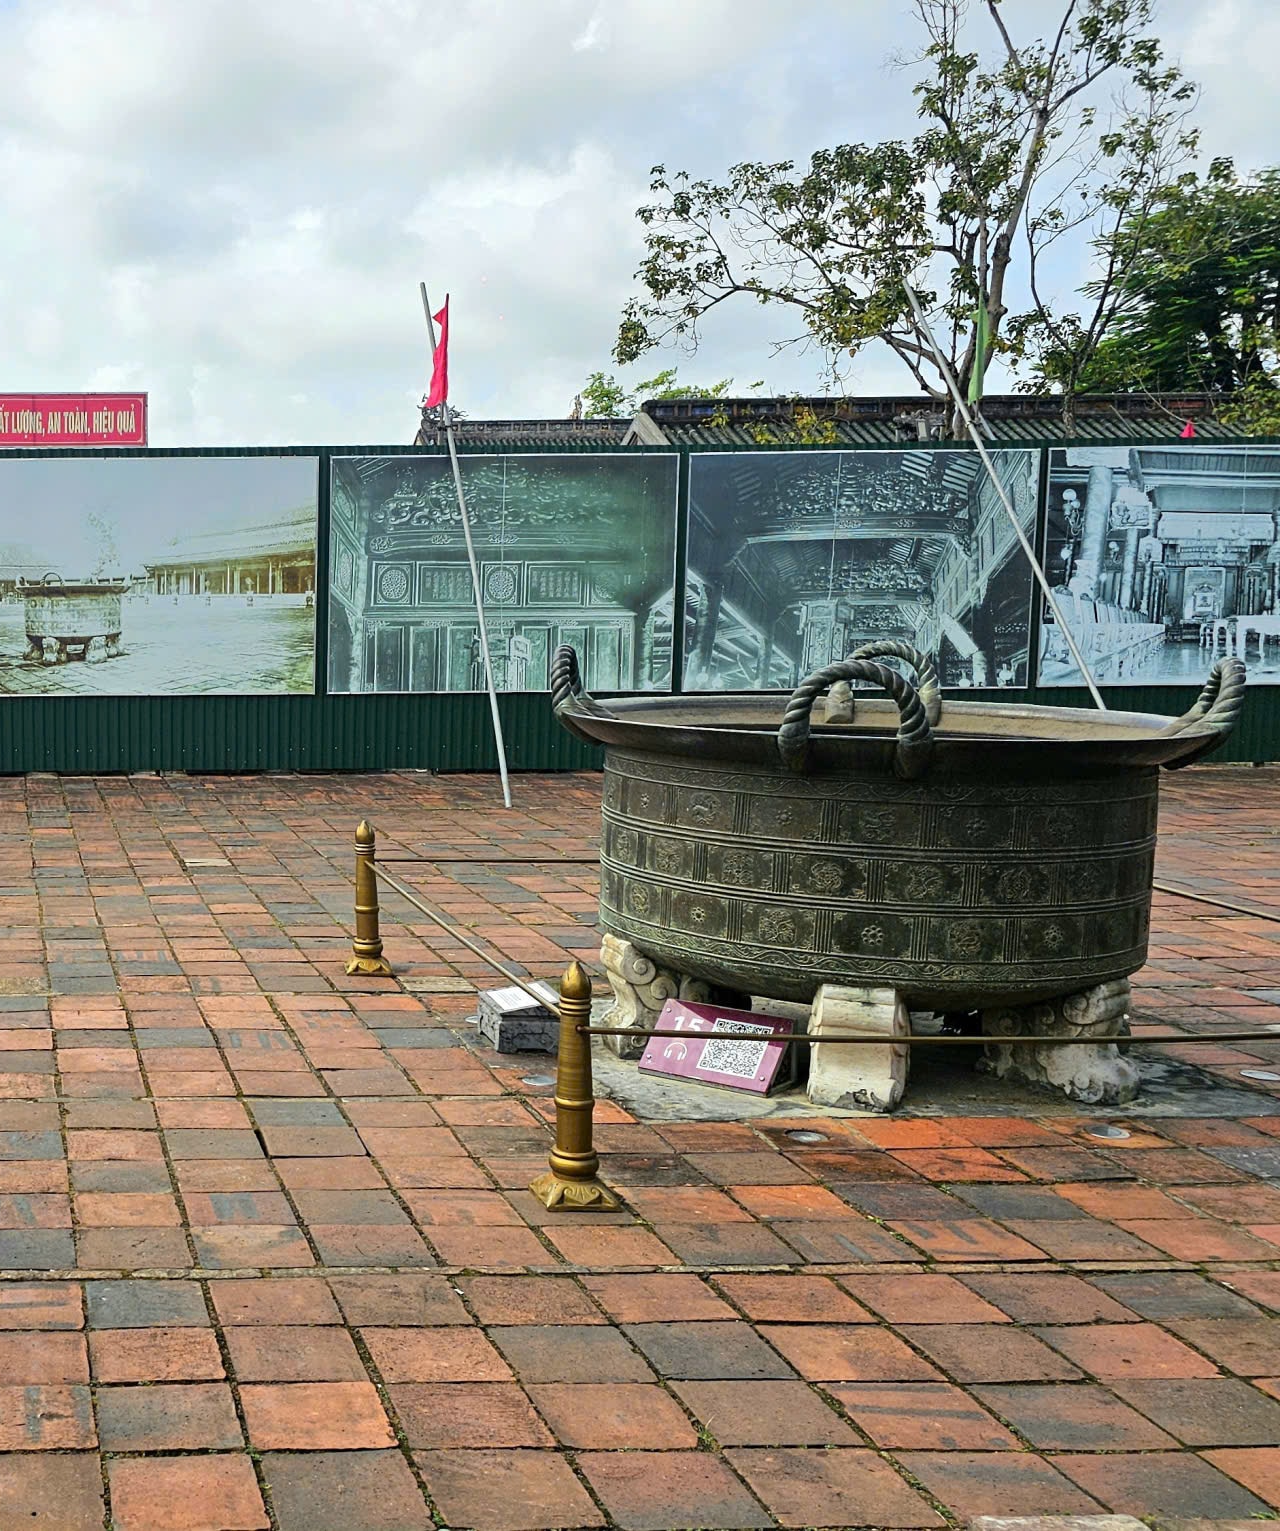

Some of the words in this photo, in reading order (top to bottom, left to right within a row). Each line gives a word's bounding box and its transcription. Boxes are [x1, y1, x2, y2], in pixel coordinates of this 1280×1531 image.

[11, 408, 45, 438] LƯỢNG,
[48, 411, 61, 434] AN
[63, 407, 91, 436] TOÀN,
[93, 406, 114, 438] HIỆU
[116, 403, 136, 435] QUẢ
[674, 1015, 705, 1032] 15
